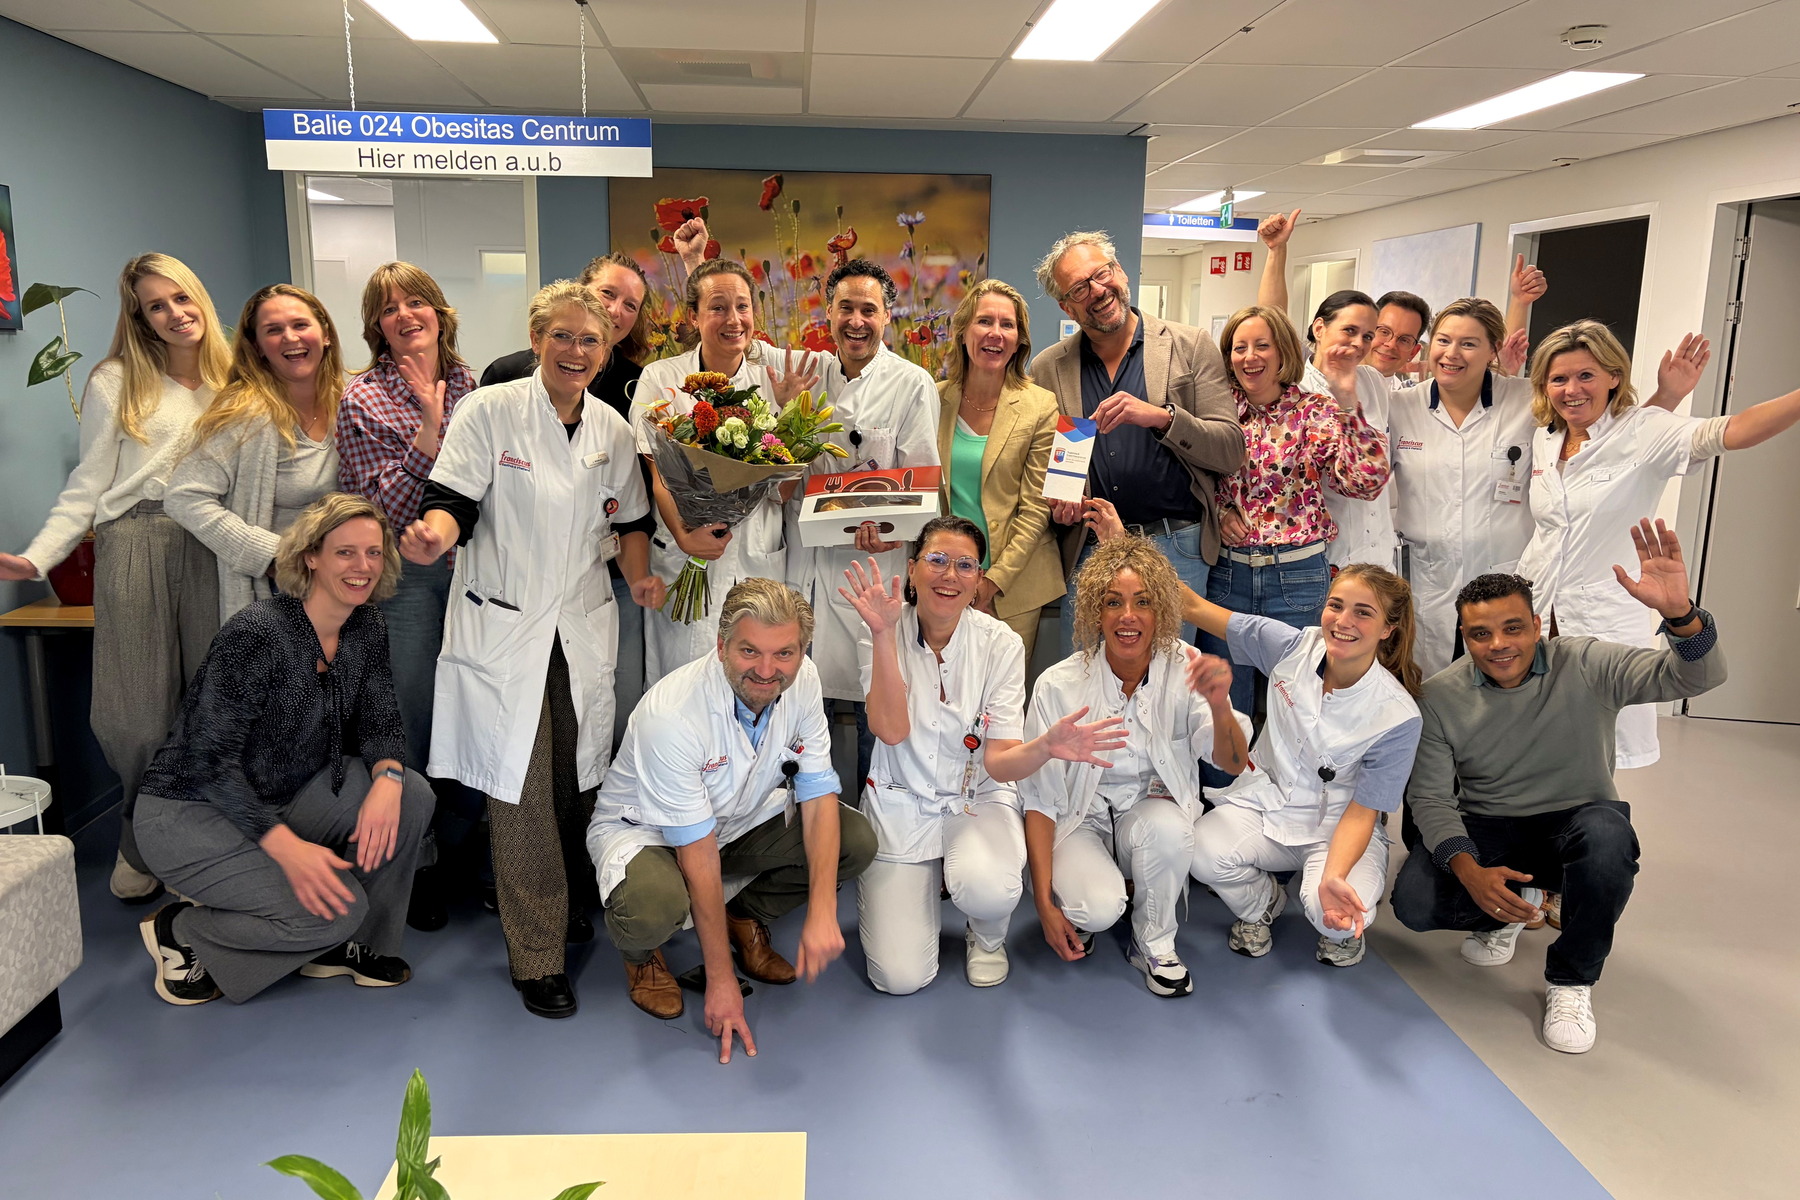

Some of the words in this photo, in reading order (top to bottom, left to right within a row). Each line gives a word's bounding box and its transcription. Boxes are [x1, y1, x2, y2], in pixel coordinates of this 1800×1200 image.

[293, 113, 352, 136] Balie
[359, 115, 403, 137] 024
[411, 116, 514, 140] Obesitas
[521, 119, 620, 141] Centrum
[358, 148, 405, 168] Hier
[413, 150, 497, 171] melden
[505, 152, 562, 172] a.u.b
[1177, 215, 1214, 226] Toiletten
[498, 450, 531, 468] franciscus
